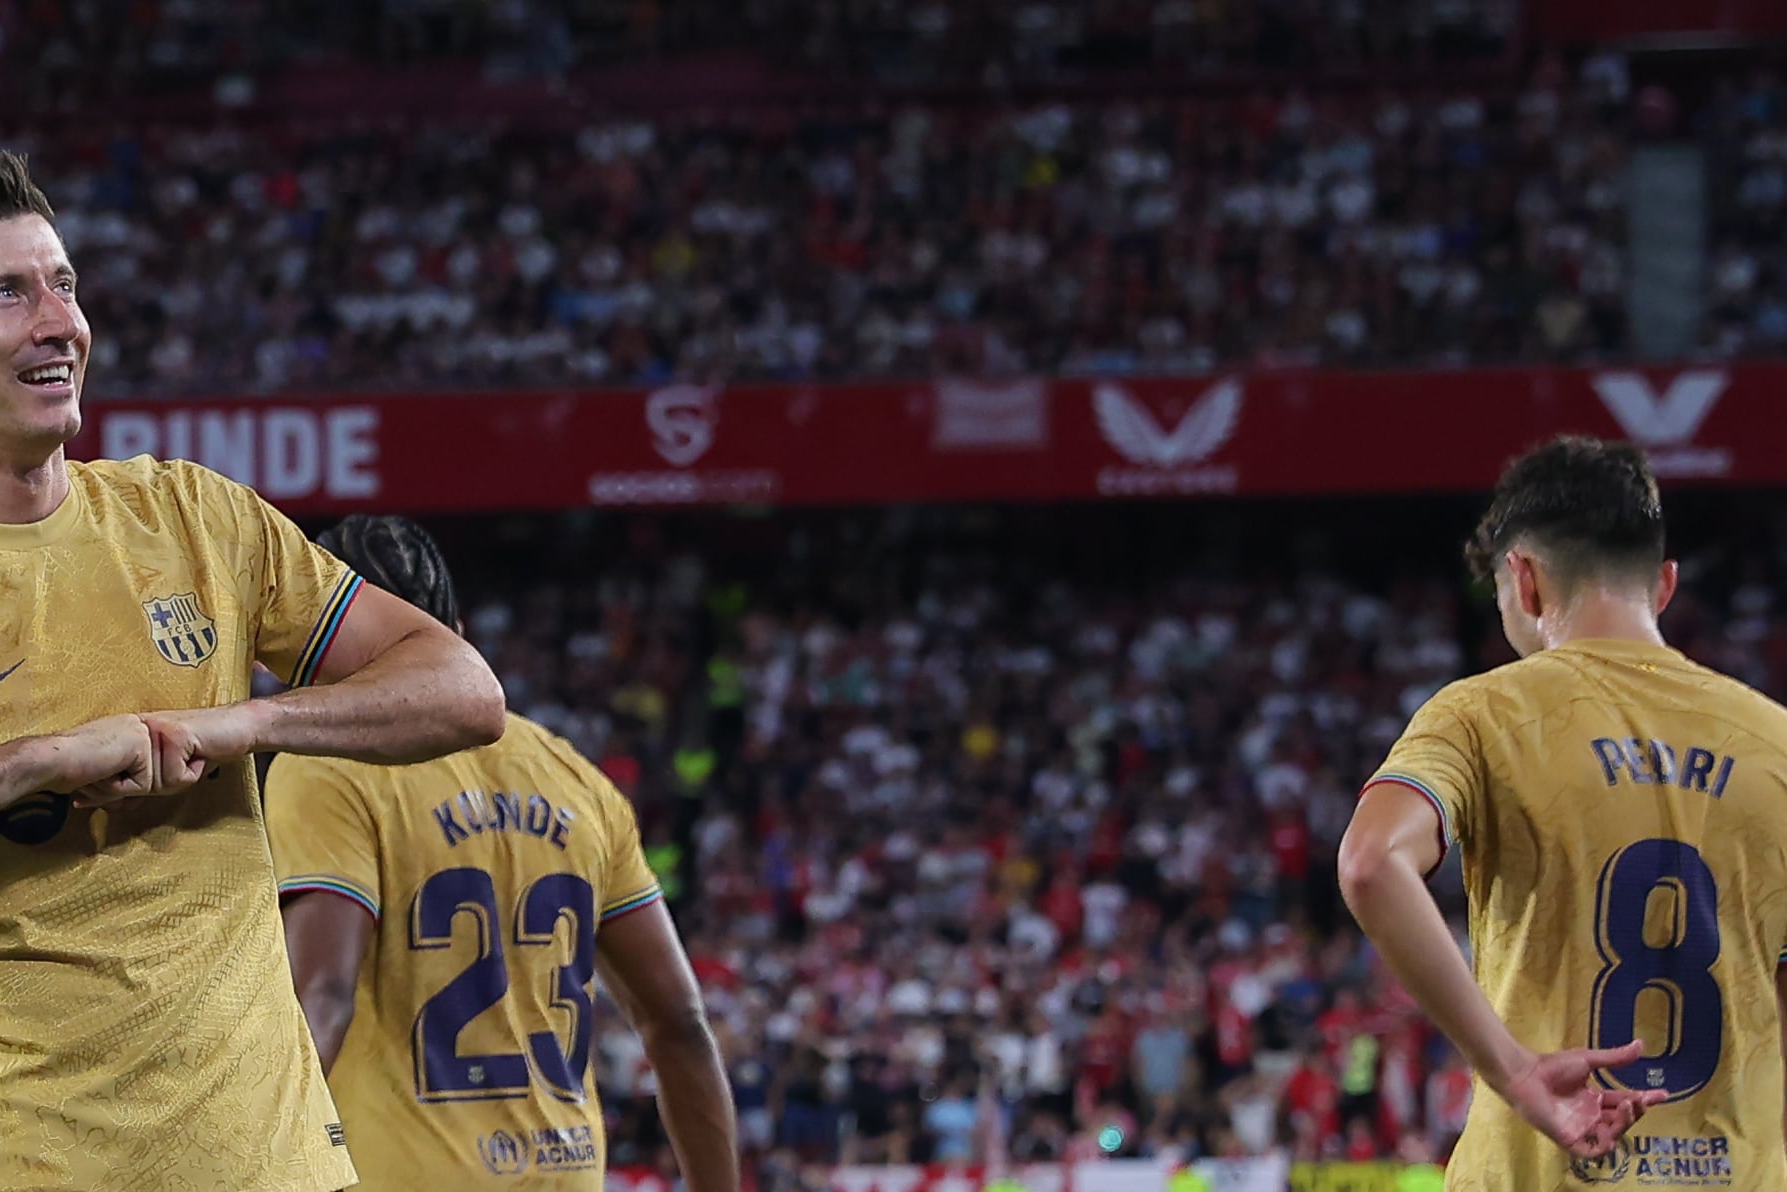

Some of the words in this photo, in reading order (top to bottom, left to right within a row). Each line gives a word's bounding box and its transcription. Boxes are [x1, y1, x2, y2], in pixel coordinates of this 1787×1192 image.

[1590, 736, 1736, 800] PEDRI
[407, 867, 595, 1105] 23
[1588, 837, 1723, 1104] 8
[535, 1144, 596, 1165] ACNUR
[1633, 1135, 1729, 1157] UNHCR
[1636, 1157, 1732, 1177] ACNUR
